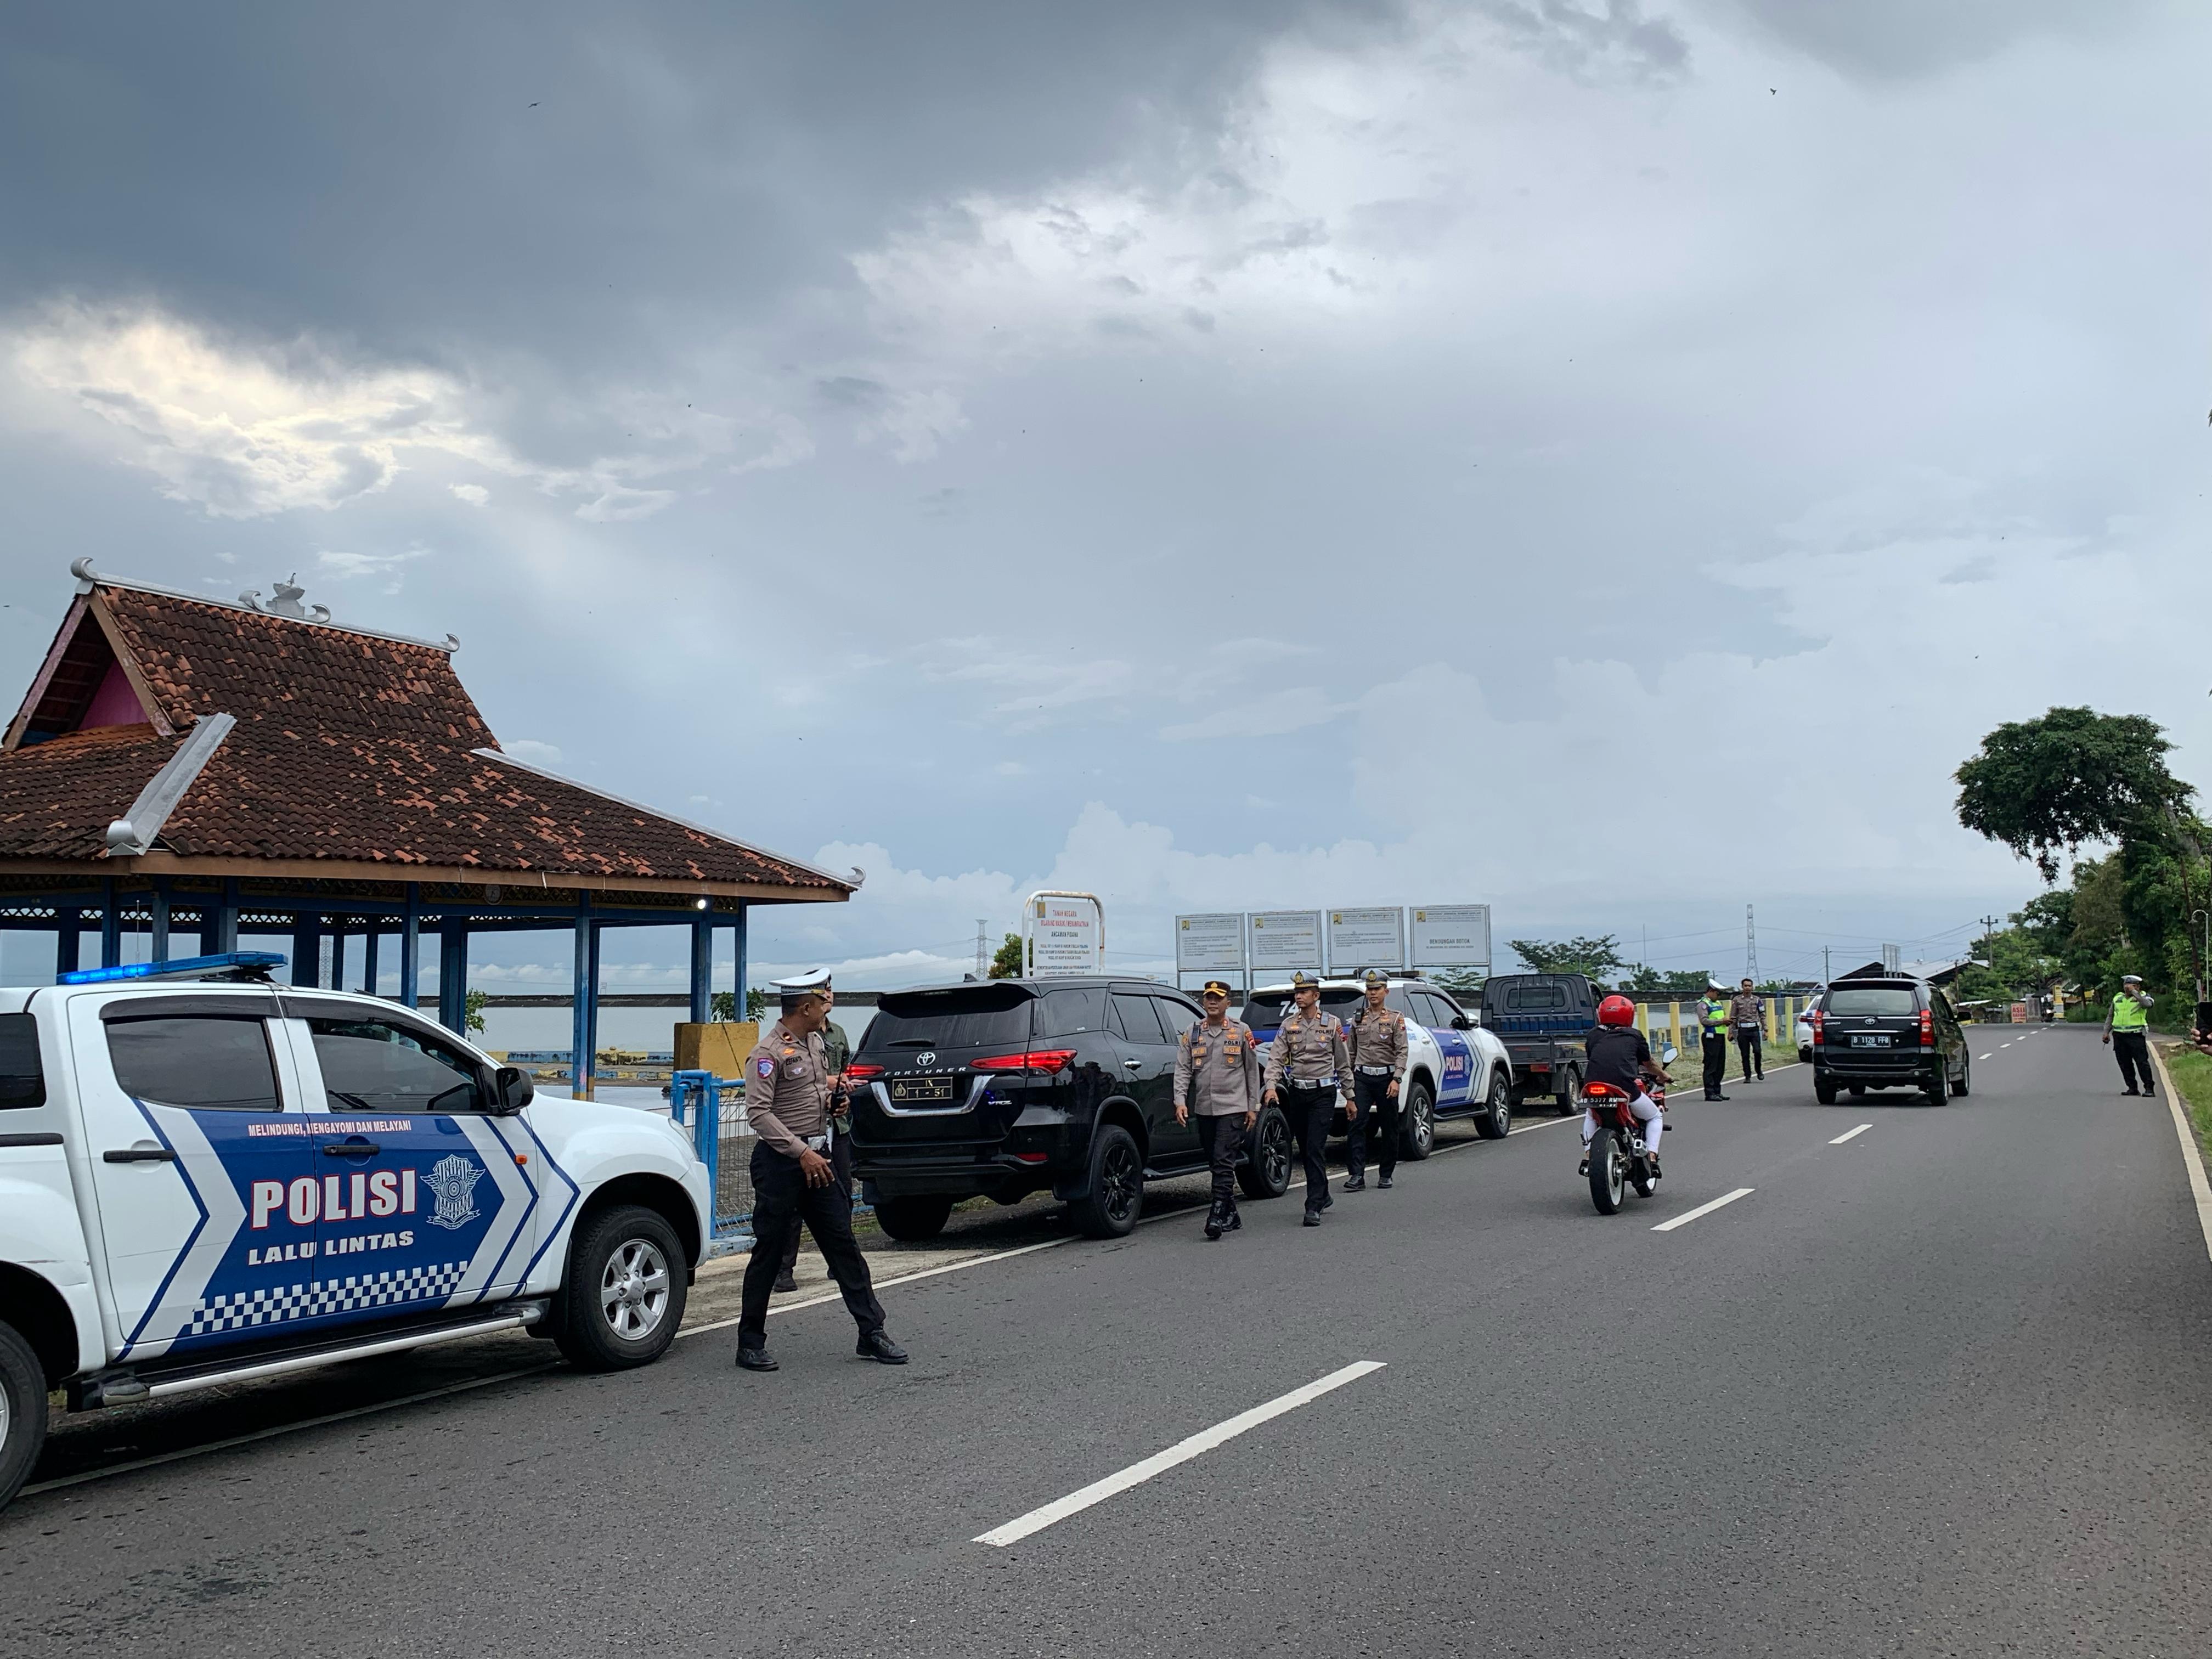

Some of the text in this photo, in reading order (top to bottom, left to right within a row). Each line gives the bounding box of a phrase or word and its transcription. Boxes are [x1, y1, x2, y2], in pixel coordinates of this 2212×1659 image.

[884, 1067, 967, 1076] FORTUNER
[1446, 1056, 1463, 1071] POLISI
[248, 1123, 306, 1137] MELINDUNGI,
[356, 1121, 373, 1132] DAN
[373, 1120, 411, 1132] MELAYANI
[250, 1167, 417, 1229] POLISI
[249, 1231, 414, 1266] LALU LINTAS
